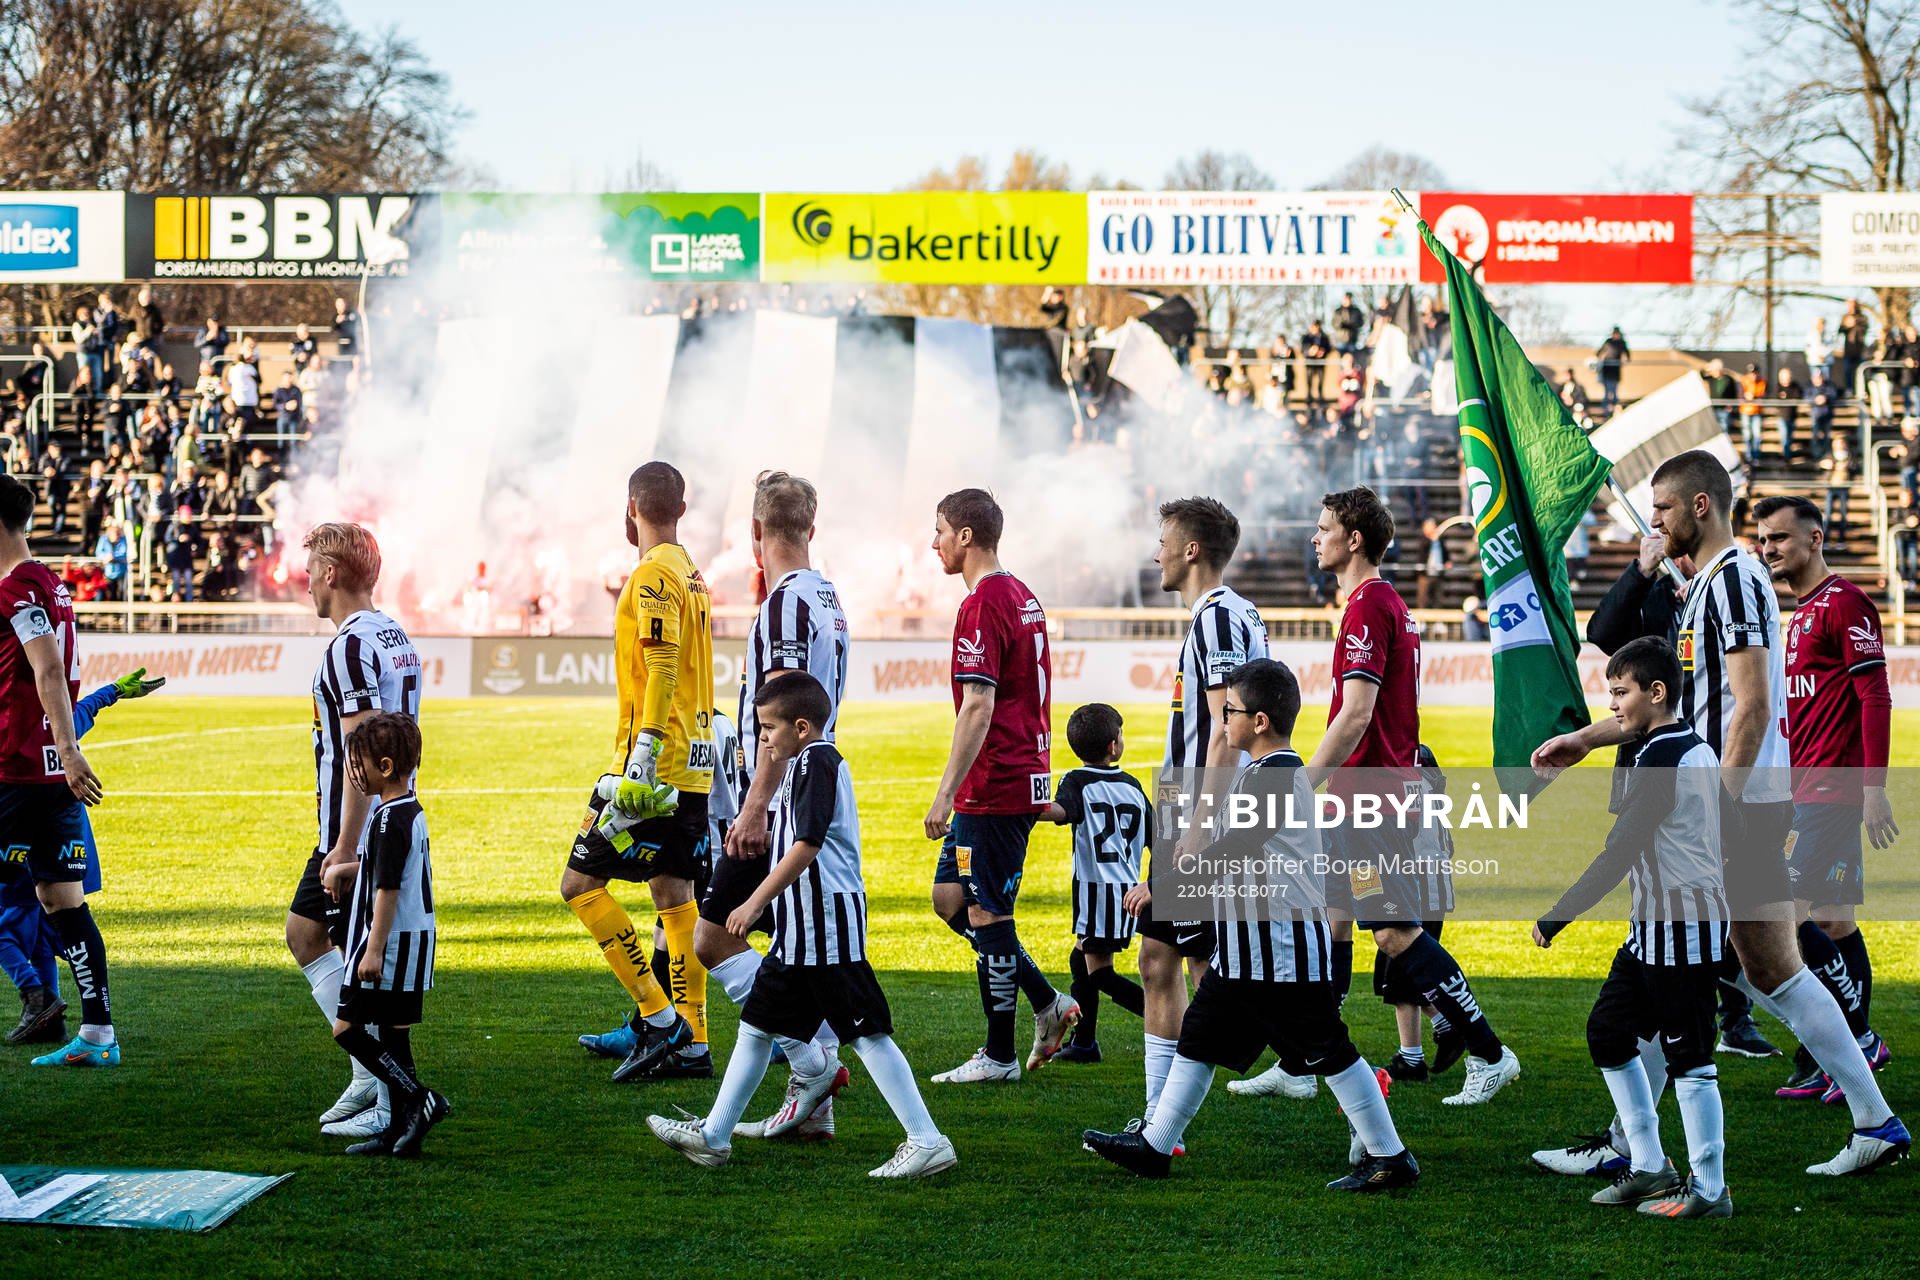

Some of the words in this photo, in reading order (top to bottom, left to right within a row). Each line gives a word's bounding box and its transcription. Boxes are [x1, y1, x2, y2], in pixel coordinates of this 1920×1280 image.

[0, 220, 71, 254] ldex
[210, 197, 410, 260] BBM
[1102, 212, 1154, 255] GO
[1171, 206, 1356, 255] BILTVÄTT
[1852, 211, 1920, 235] COMFO
[848, 225, 1060, 271] bakertilly
[154, 261, 257, 277] BORSTAHUSENS
[257, 261, 299, 277] BYGG
[301, 262, 313, 277] &
[640, 600, 672, 611] QUALITY
[1727, 622, 1760, 633] stadium
[772, 648, 806, 661] stadium
[957, 653, 986, 663] QUALITY
[1346, 650, 1373, 661] QUALITY
[344, 687, 378, 700] stadium
[67, 941, 97, 999] MIKE
[616, 924, 651, 978] MIKE
[672, 953, 688, 1005] MIKE
[987, 954, 1017, 1012] MIKE
[1439, 970, 1483, 1023] MIKE
[1824, 952, 1861, 1012] MIKE
